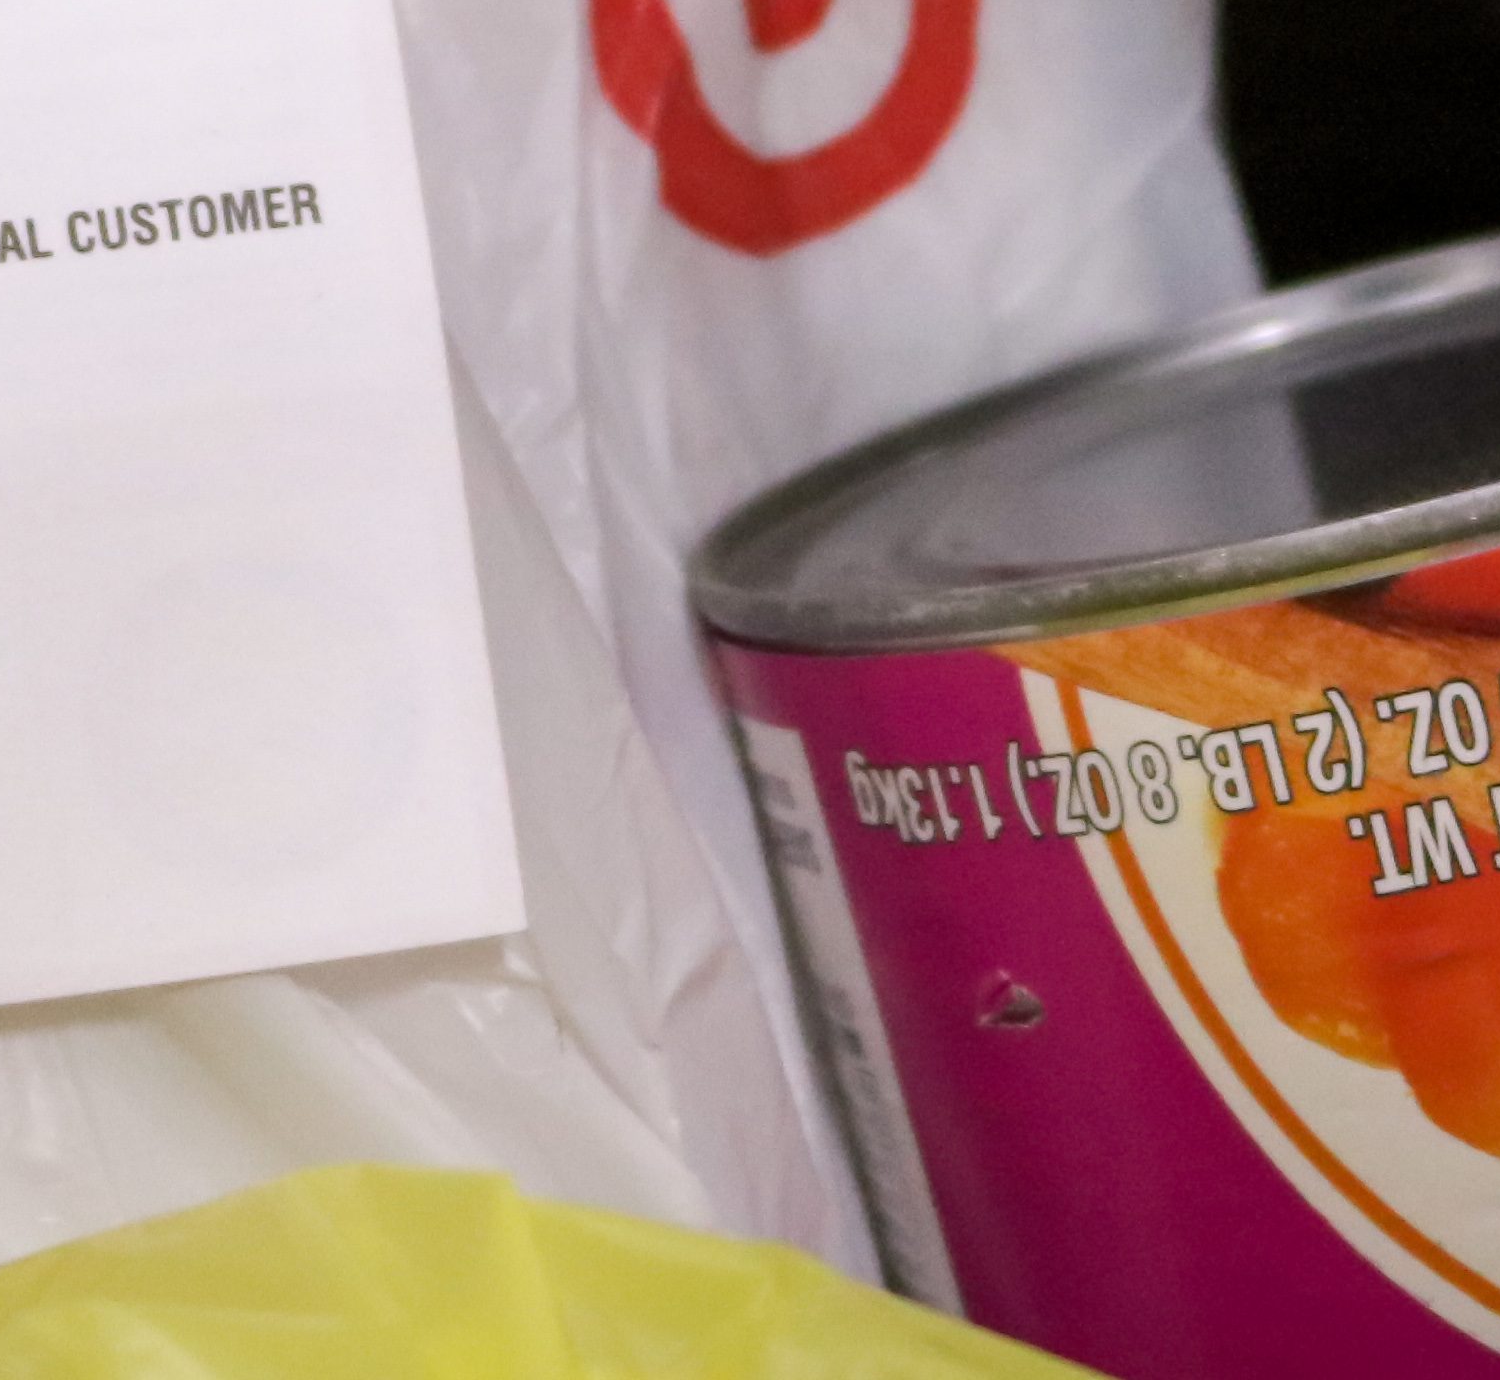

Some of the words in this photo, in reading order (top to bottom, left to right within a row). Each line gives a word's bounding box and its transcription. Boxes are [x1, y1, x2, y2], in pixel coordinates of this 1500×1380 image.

[67, 182, 322, 255] CUSTOMER
[1177, 721, 1293, 814] LB.
[1293, 687, 1366, 791] (2
[1374, 679, 1491, 778] OZ.
[845, 750, 1001, 843] 1.13kg
[1007, 740, 1124, 839] OZ.)
[1130, 740, 1178, 824] 8
[1348, 796, 1478, 896] WT.
